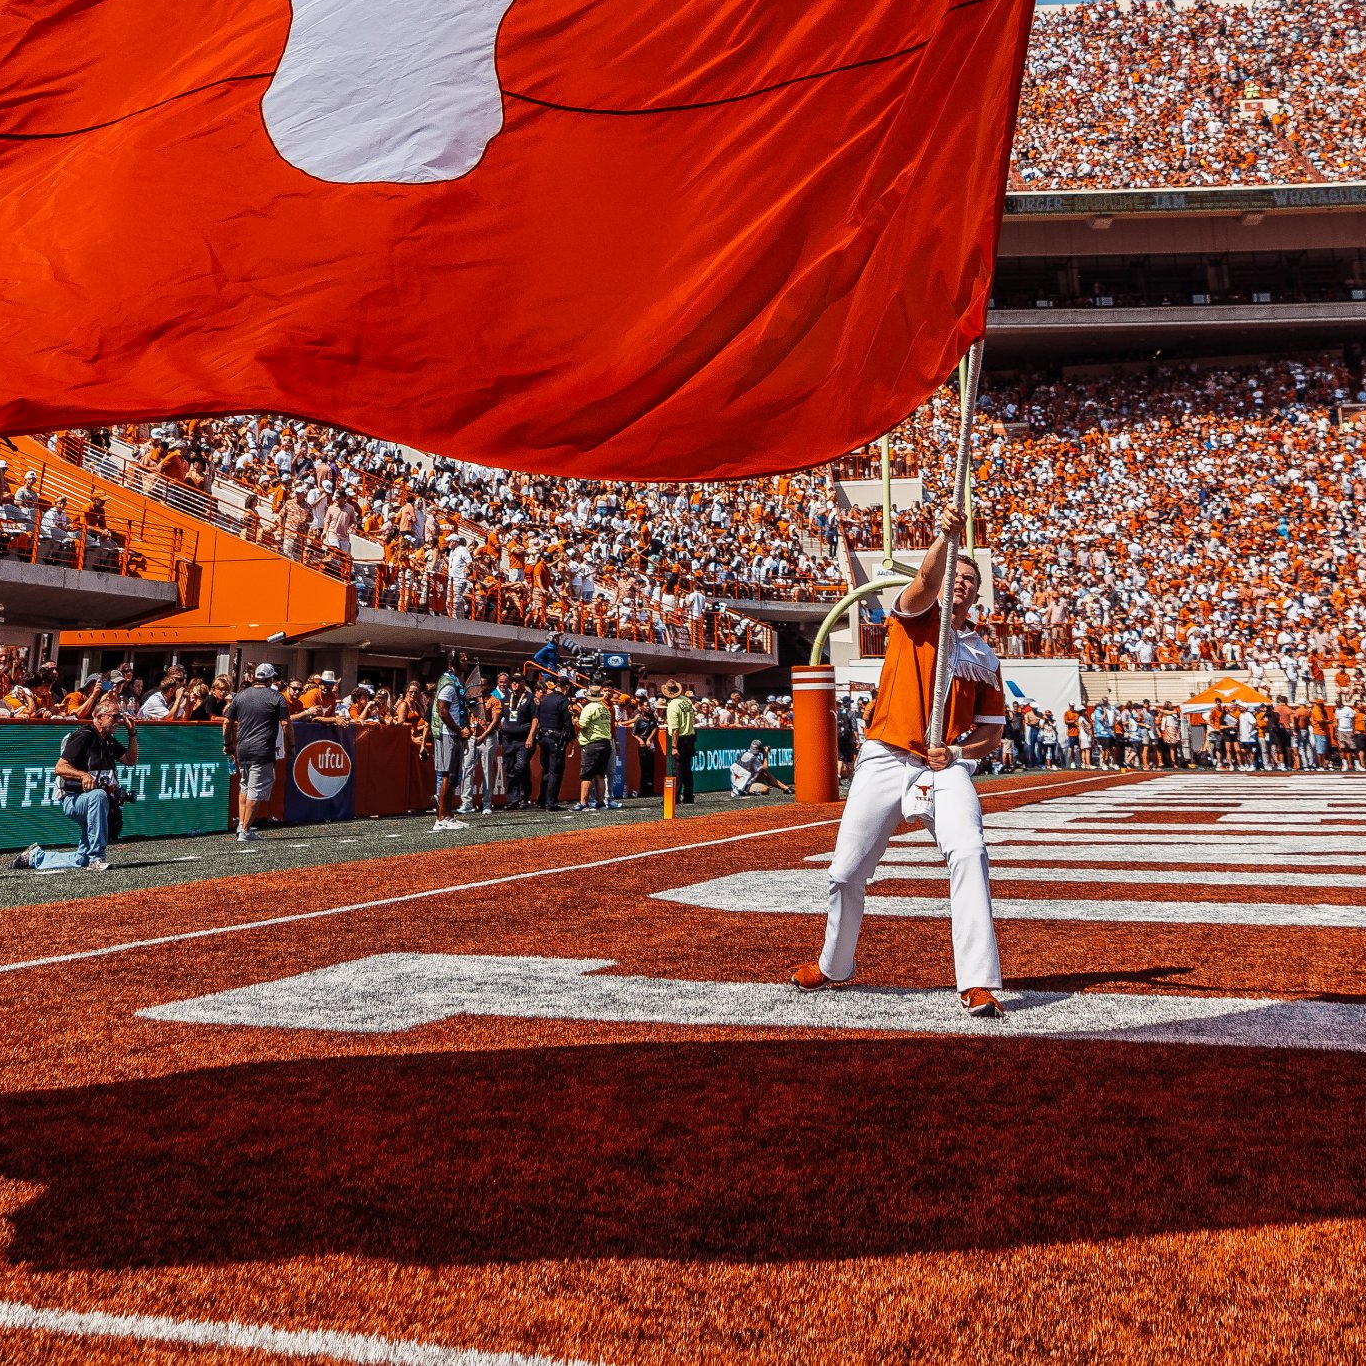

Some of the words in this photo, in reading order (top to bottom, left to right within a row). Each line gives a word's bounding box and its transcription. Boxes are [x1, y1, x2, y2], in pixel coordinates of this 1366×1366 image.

[1150, 192, 1186, 210] JAM
[318, 747, 344, 769] ufcu
[778, 748, 794, 766] LINE
[158, 762, 216, 800] LINE
